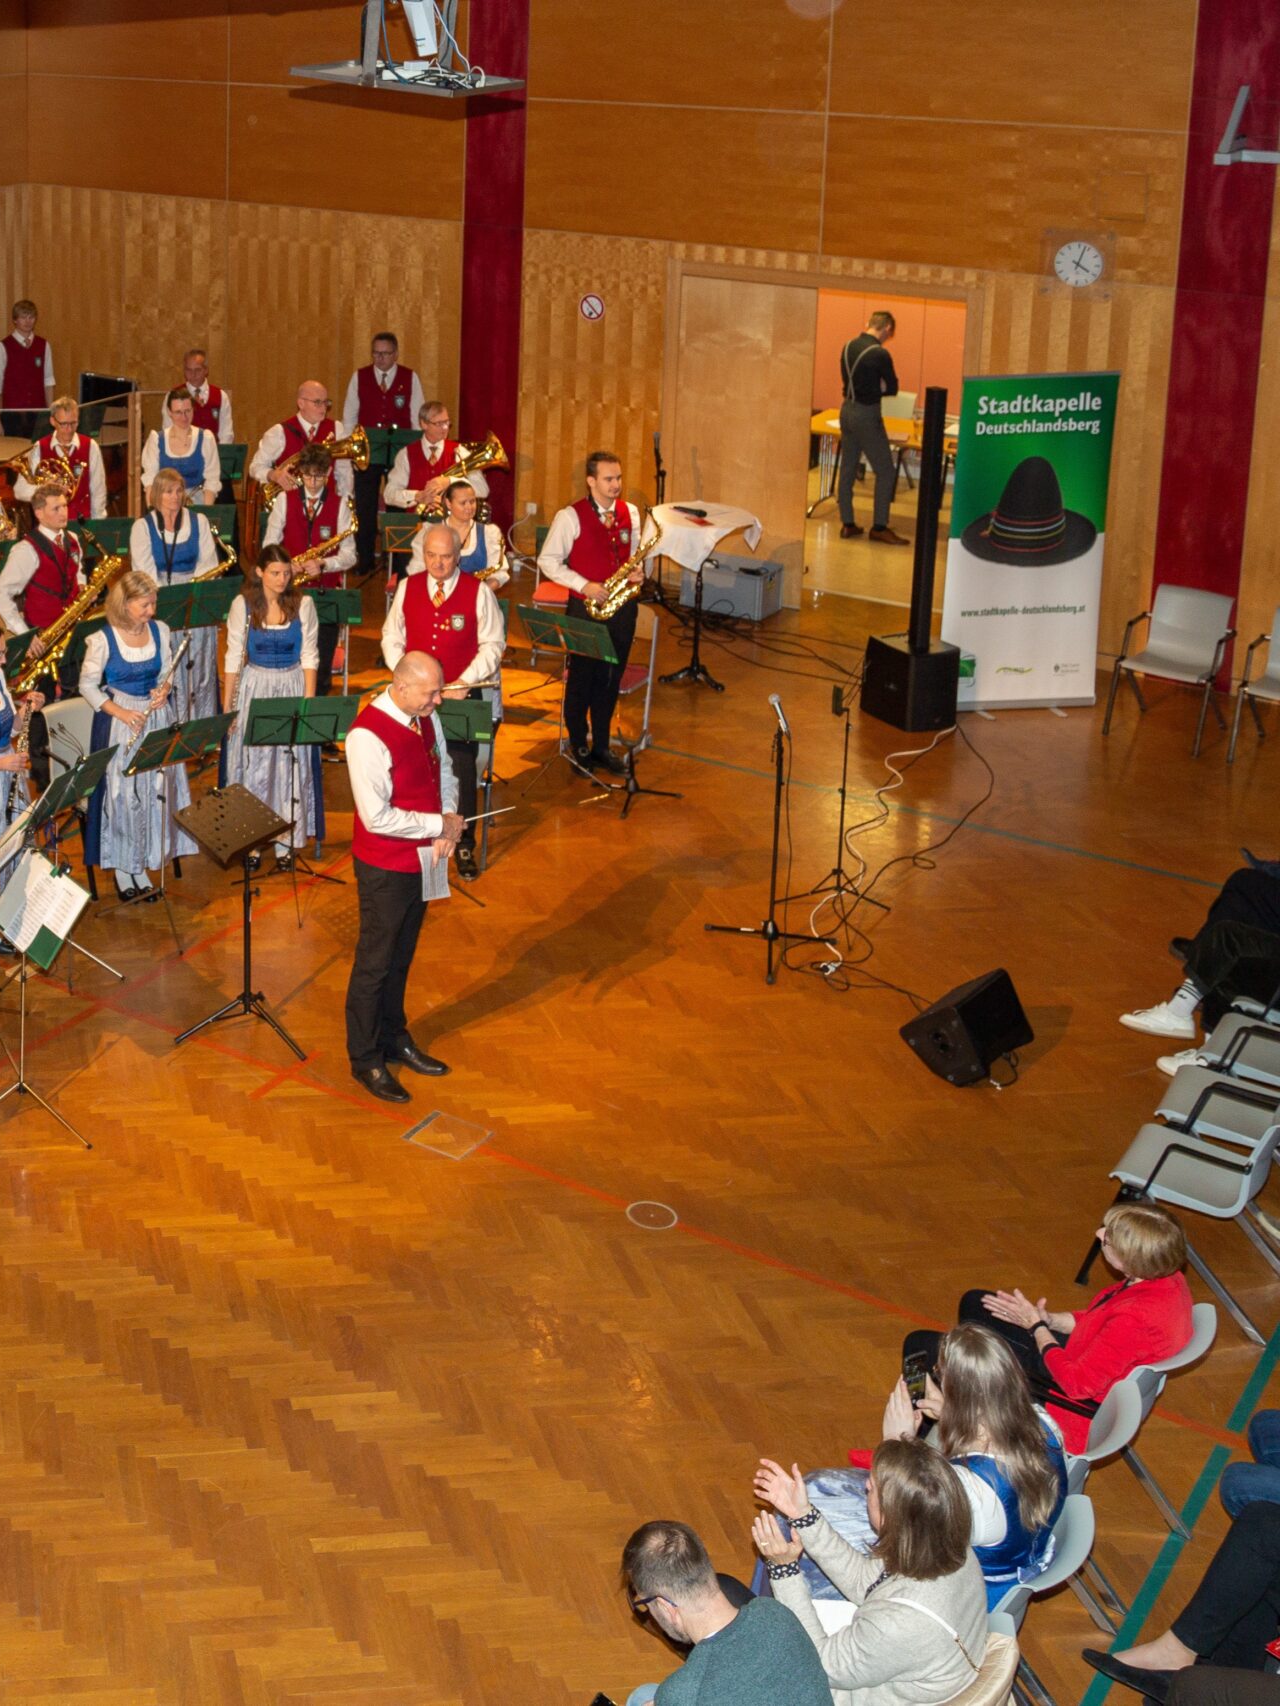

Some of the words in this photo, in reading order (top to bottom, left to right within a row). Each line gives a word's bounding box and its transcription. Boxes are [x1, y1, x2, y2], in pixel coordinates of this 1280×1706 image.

[978, 392, 1102, 417] Stadtkapelle
[976, 418, 1100, 435] Deutschlandsberg
[961, 605, 1086, 617] www.stadtkapelle-deutschlandsberg.at
